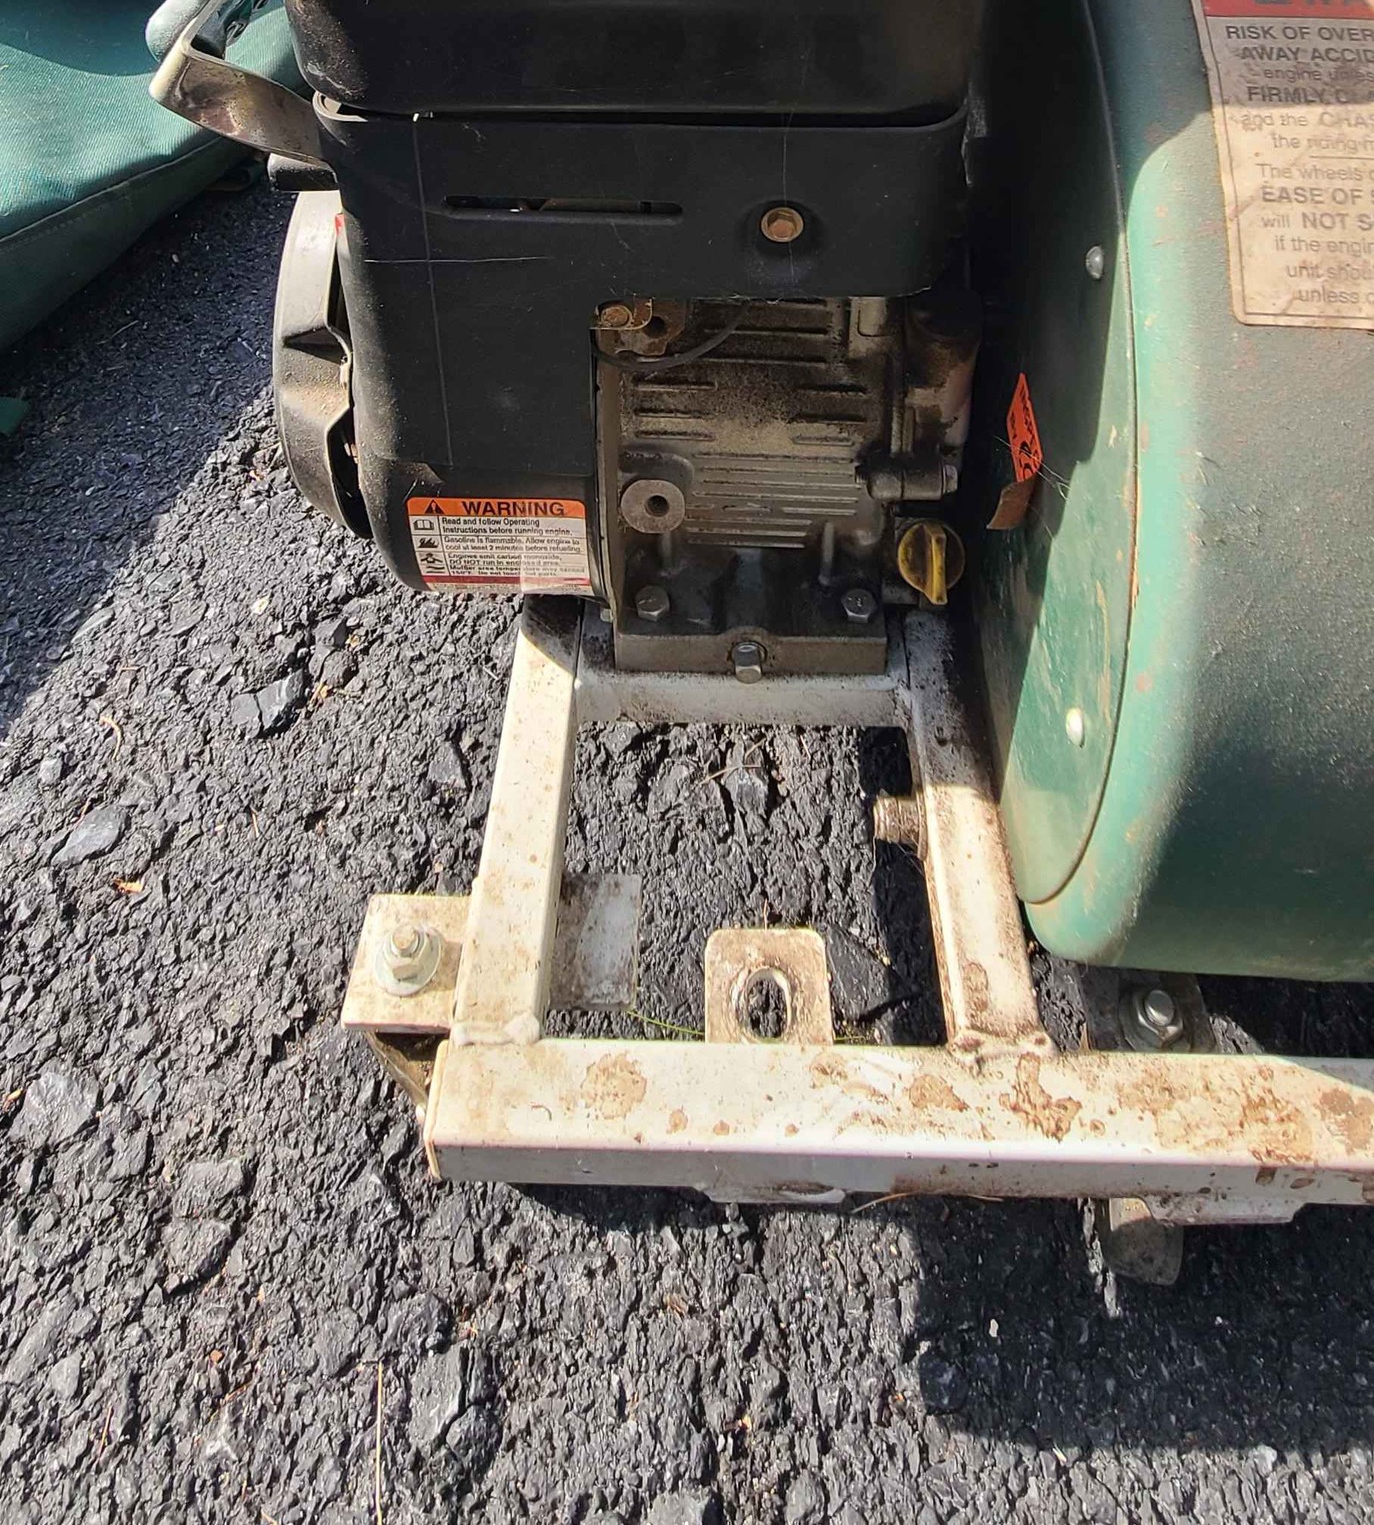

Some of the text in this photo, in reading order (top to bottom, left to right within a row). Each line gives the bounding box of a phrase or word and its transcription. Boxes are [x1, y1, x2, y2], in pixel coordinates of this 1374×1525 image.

[1226, 25, 1278, 40] RISK
[1282, 26, 1311, 40] OF
[1240, 46, 1300, 61] AWAY
[1264, 69, 1321, 84] engine
[1247, 85, 1328, 103] FIRMLY
[1273, 134, 1300, 149] the
[1256, 163, 1292, 179] The
[1262, 186, 1325, 204] EASE
[1332, 187, 1363, 205] OF
[1262, 214, 1290, 229] will
[1302, 212, 1349, 231] NOT
[1275, 235, 1287, 251] if
[1291, 236, 1320, 253] the
[1287, 259, 1321, 279] unit
[1298, 285, 1360, 304] unless
[462, 501, 565, 516] WARNING
[442, 517, 460, 525] Read
[503, 518, 539, 528] Operating
[515, 527, 543, 536] running
